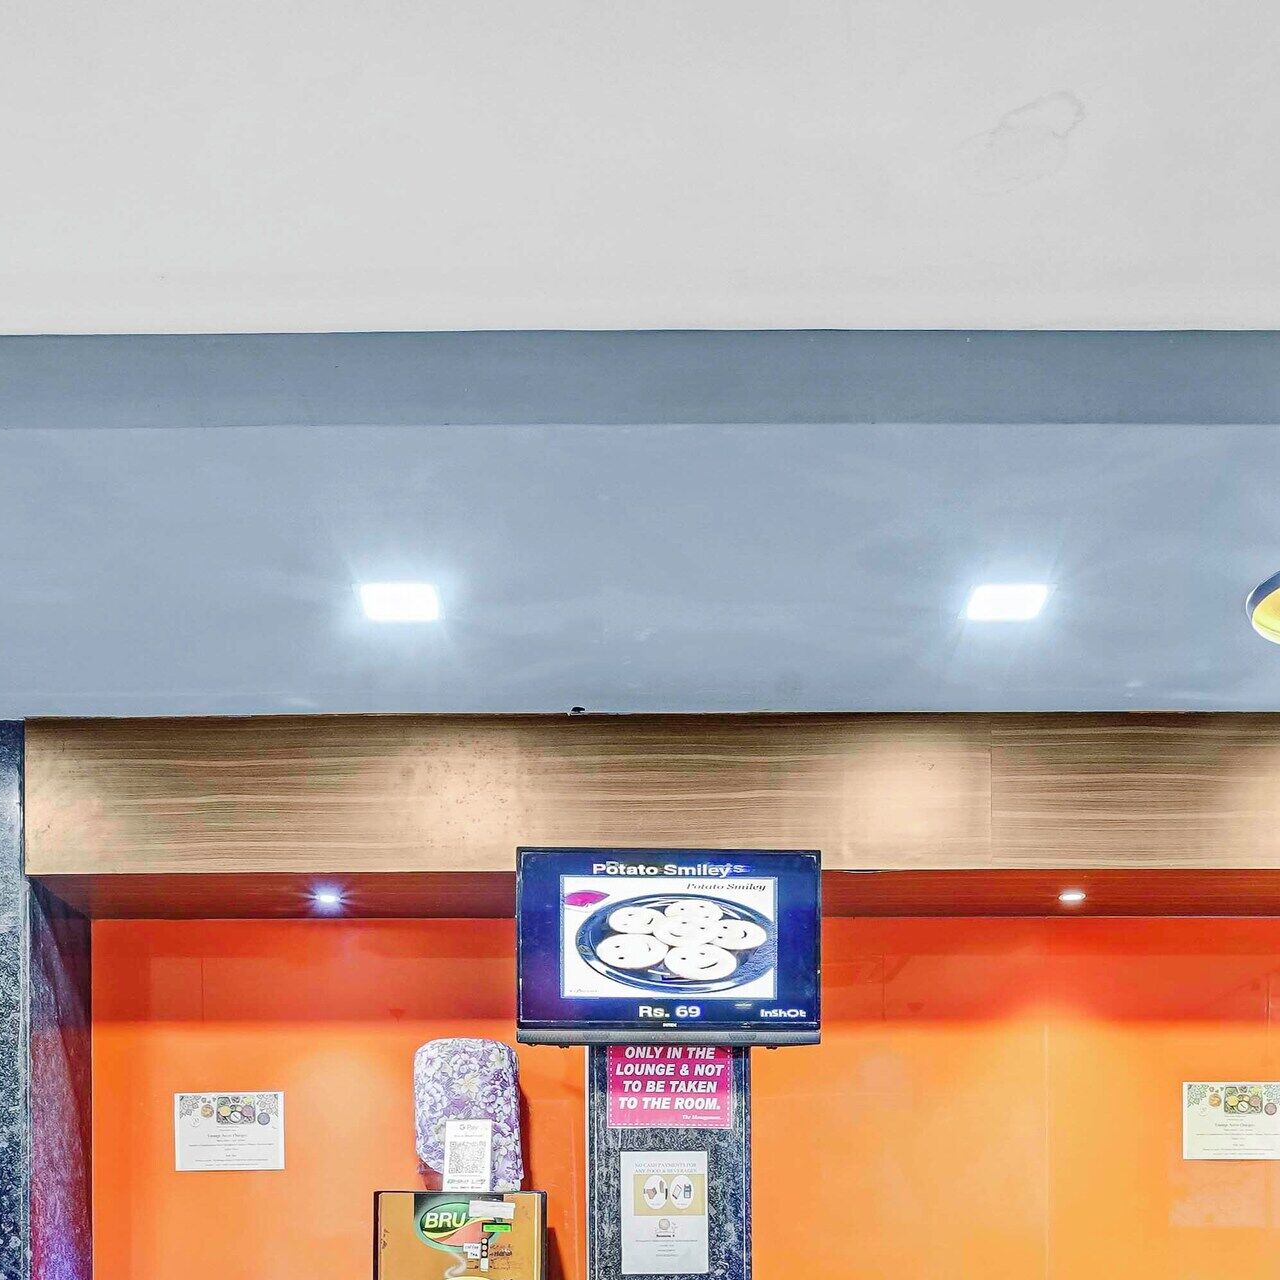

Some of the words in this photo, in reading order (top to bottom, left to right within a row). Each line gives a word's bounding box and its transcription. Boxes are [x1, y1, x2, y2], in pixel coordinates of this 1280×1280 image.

[593, 862, 658, 876] Potato
[726, 883, 766, 892] Smiley
[638, 1005, 670, 1018] Rs.
[675, 1005, 701, 1018] 69
[624, 1046, 664, 1059] ONLY
[666, 1047, 683, 1059] IN
[687, 1047, 716, 1060] THE
[615, 1063, 676, 1076] LOUNGE
[679, 1064, 690, 1076] &
[694, 1064, 725, 1077] NOT
[623, 1080, 642, 1093] TO
[645, 1081, 665, 1093] BE
[669, 1081, 718, 1093] TAKEN
[618, 1097, 638, 1110] TO
[642, 1097, 671, 1110] THE
[674, 1097, 721, 1110] ROOM.
[424, 1212, 467, 1229] BRU
